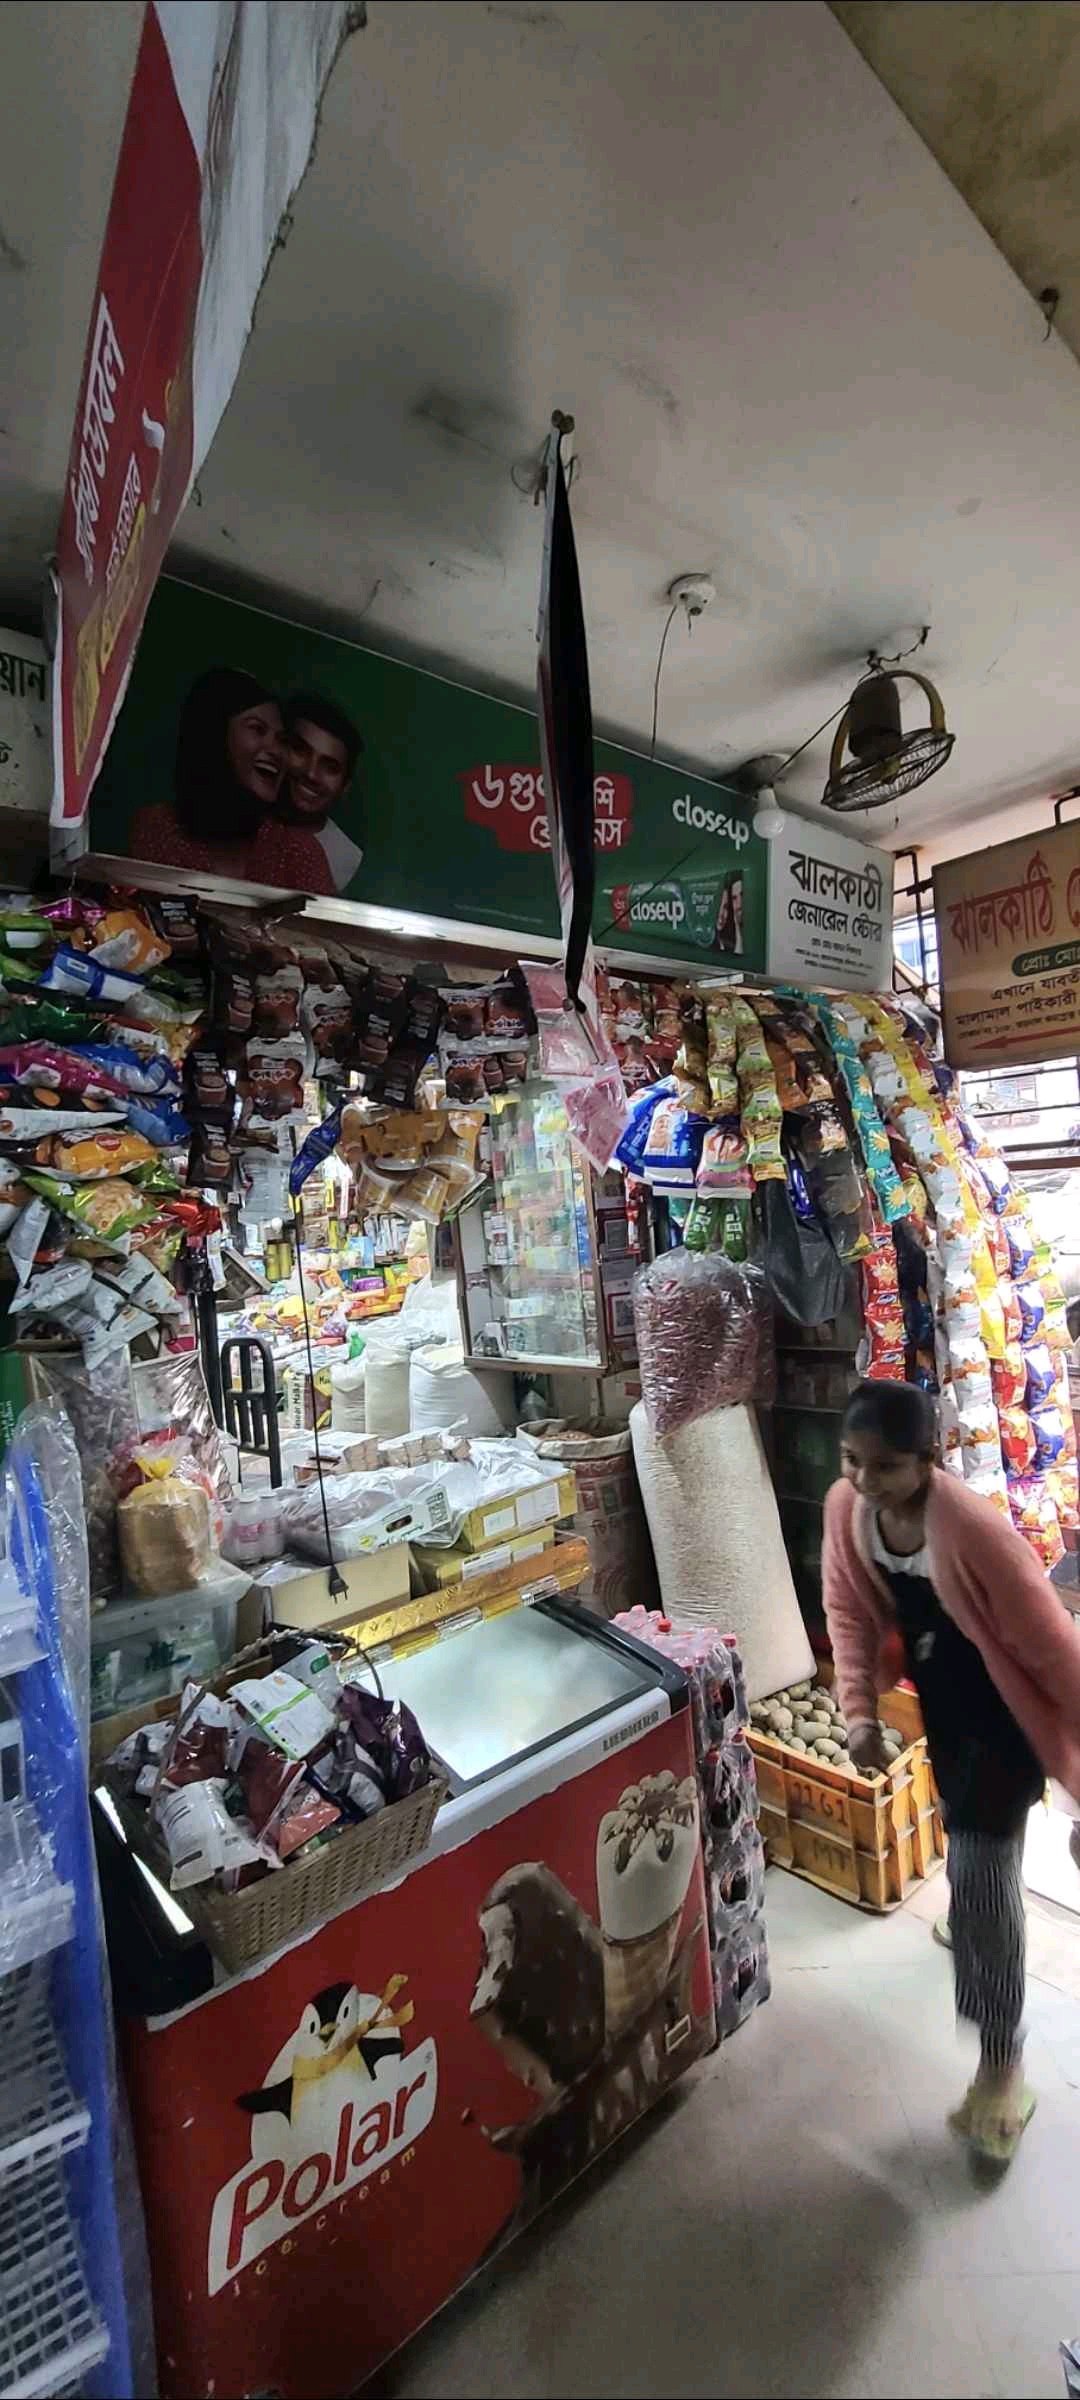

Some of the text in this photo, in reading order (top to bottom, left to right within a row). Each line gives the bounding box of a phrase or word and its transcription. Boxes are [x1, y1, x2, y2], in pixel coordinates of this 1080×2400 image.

[472, 764, 505, 808] ৬
[509, 772, 547, 812] গু
[672, 794, 750, 851] closeup
[788, 850, 884, 913] ঝালকাঠী
[631, 898, 686, 931] closeup
[788, 898, 849, 935] জেনারেল
[991, 981, 1035, 1001] এখানে
[226, 2070, 428, 2270] Polar
